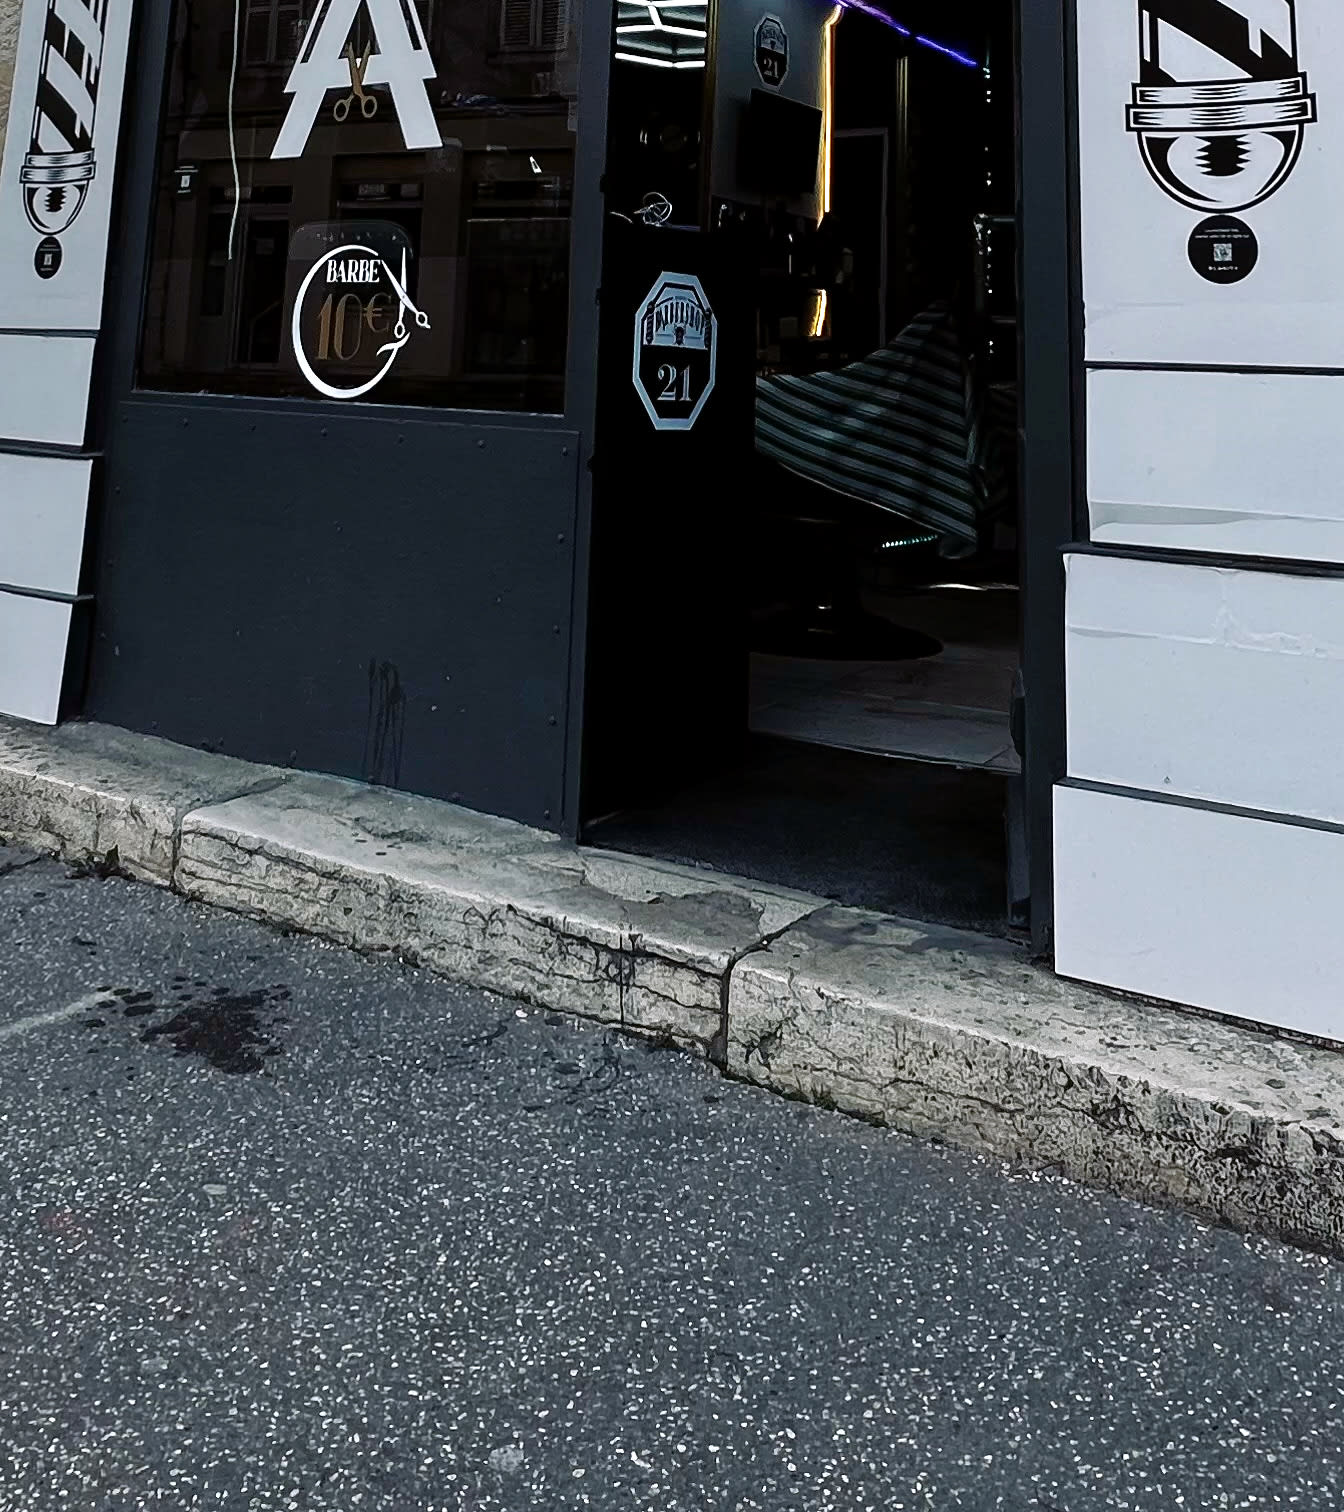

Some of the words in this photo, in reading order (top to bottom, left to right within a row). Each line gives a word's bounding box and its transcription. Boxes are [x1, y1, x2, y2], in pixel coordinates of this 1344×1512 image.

[326, 259, 381, 283] BARBE
[316, 292, 392, 361] 10€
[657, 363, 693, 402] 21
